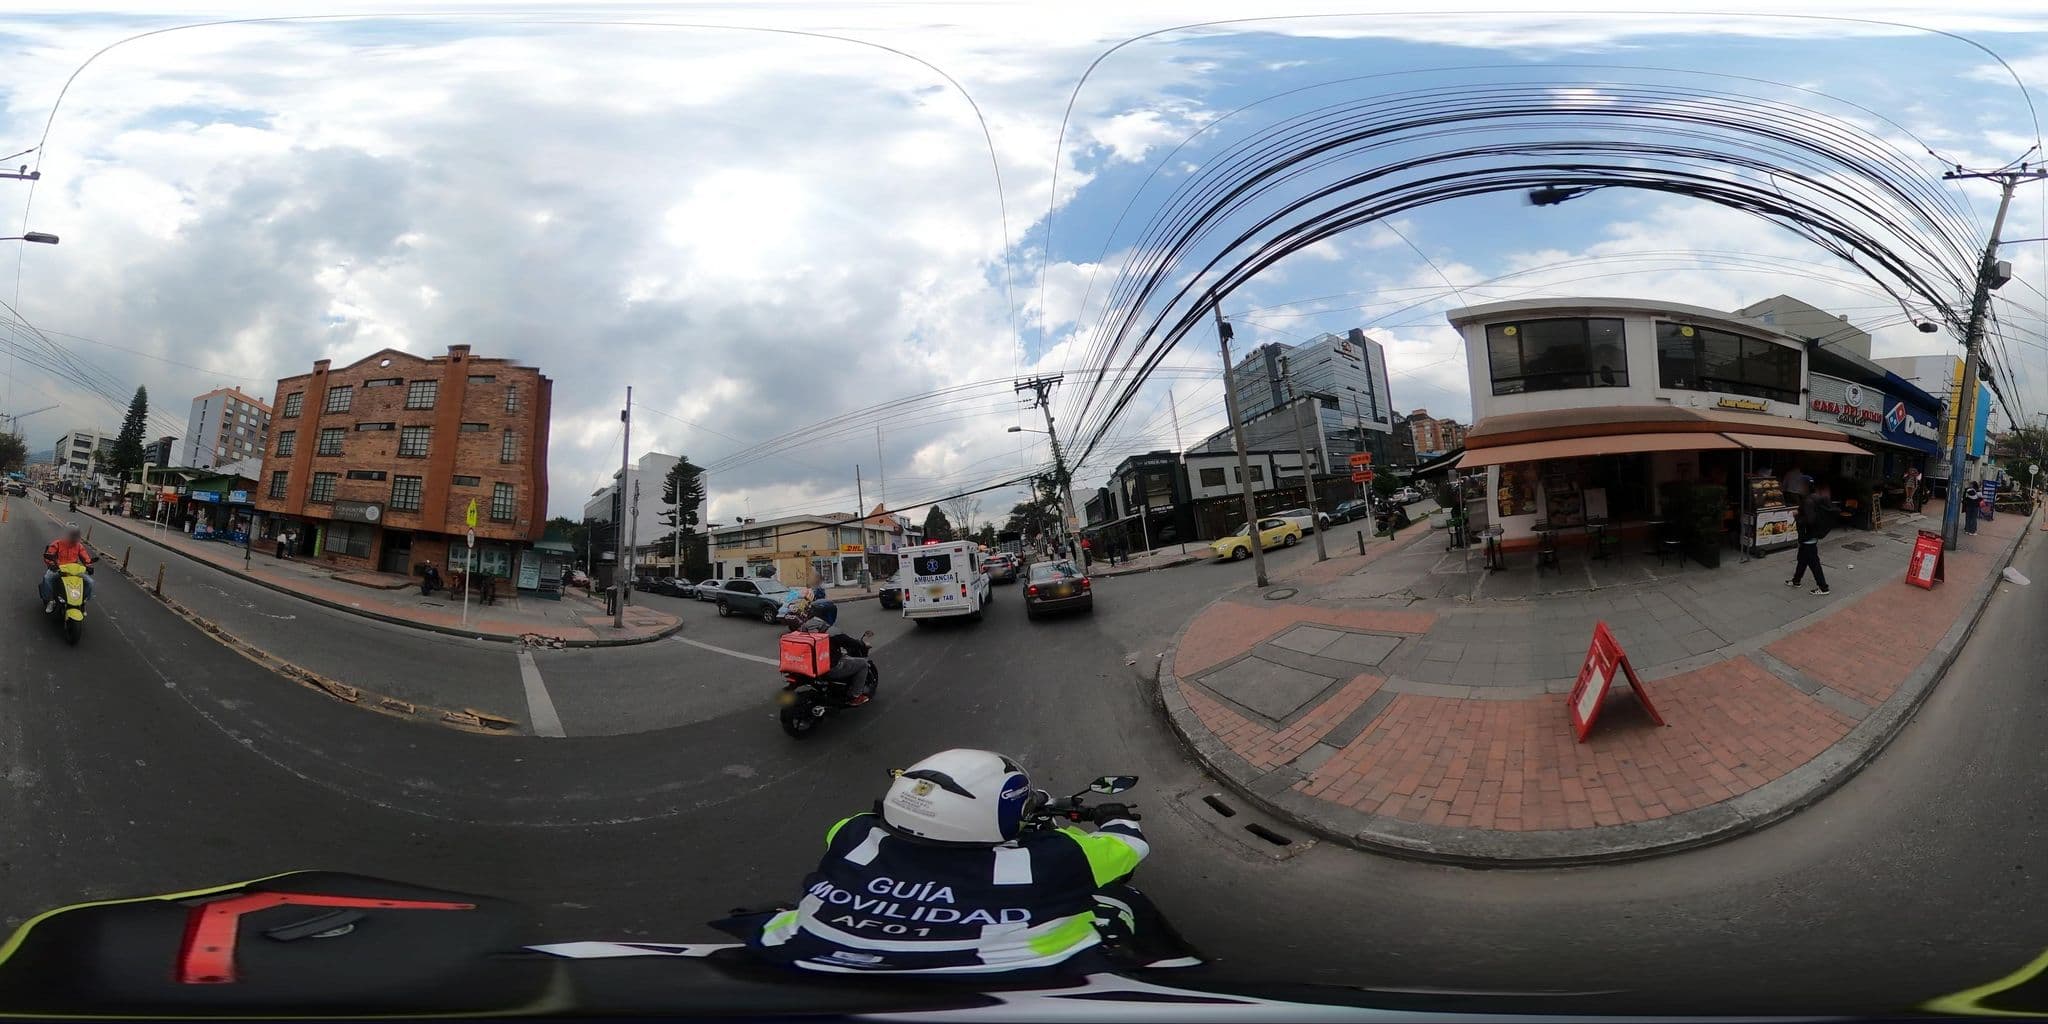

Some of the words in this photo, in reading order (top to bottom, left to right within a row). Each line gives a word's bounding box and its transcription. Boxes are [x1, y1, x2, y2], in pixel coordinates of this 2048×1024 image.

[1811, 399, 1841, 414] CASA
[914, 574, 954, 583] AMBULANCIA
[867, 876, 956, 904] GUÍA
[808, 881, 1032, 924] MOVILIDAD
[831, 914, 932, 937] AF01
